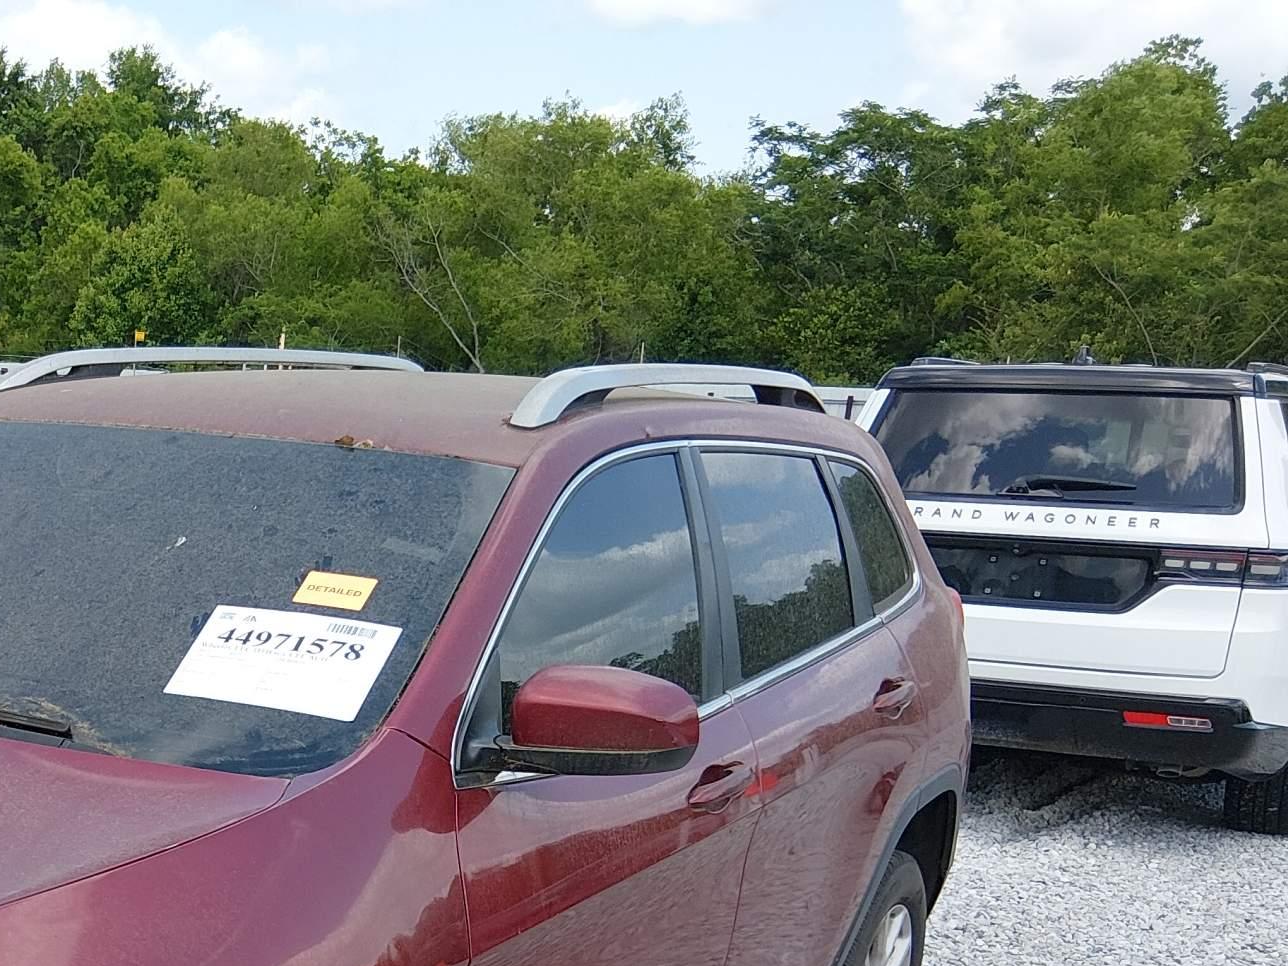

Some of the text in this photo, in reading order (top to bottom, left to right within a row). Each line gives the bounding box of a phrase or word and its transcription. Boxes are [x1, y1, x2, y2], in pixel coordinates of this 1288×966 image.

[914, 506, 1160, 529] RAND WAGONEER
[307, 584, 362, 597] DETAILED
[217, 628, 365, 661] 44971578
